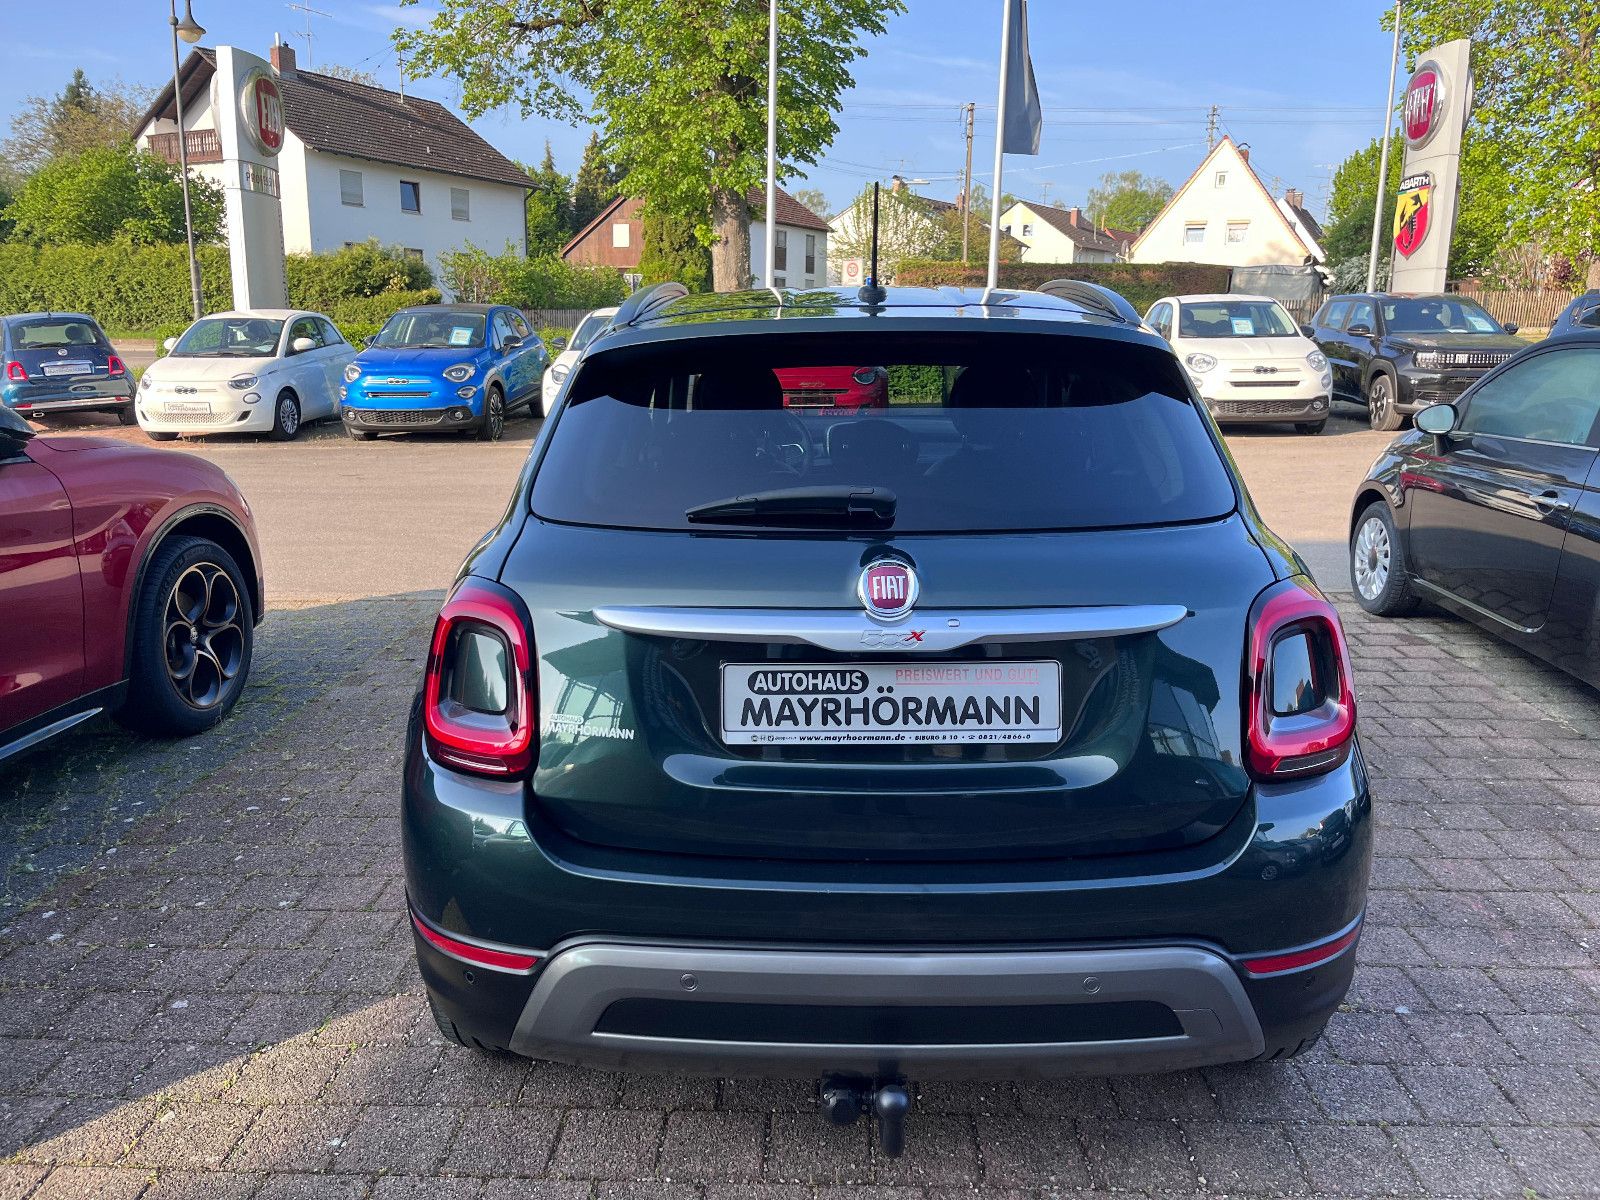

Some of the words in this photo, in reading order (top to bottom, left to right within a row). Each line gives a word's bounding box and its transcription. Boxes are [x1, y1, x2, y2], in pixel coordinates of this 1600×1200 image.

[1400, 176, 1430, 190] ABARTH
[872, 575, 905, 599] FIAT
[753, 672, 863, 692] AUTOHAUS
[895, 668, 970, 681] PREISWERT
[975, 668, 1003, 681] UND
[1007, 668, 1040, 681] GUT!
[740, 686, 1040, 727] MAYRHÖRMANN
[545, 721, 635, 740] MAYRHÖRMANN
[799, 733, 905, 743] www.mayrhoermann.de
[978, 733, 1031, 741] 0821/4866-0
